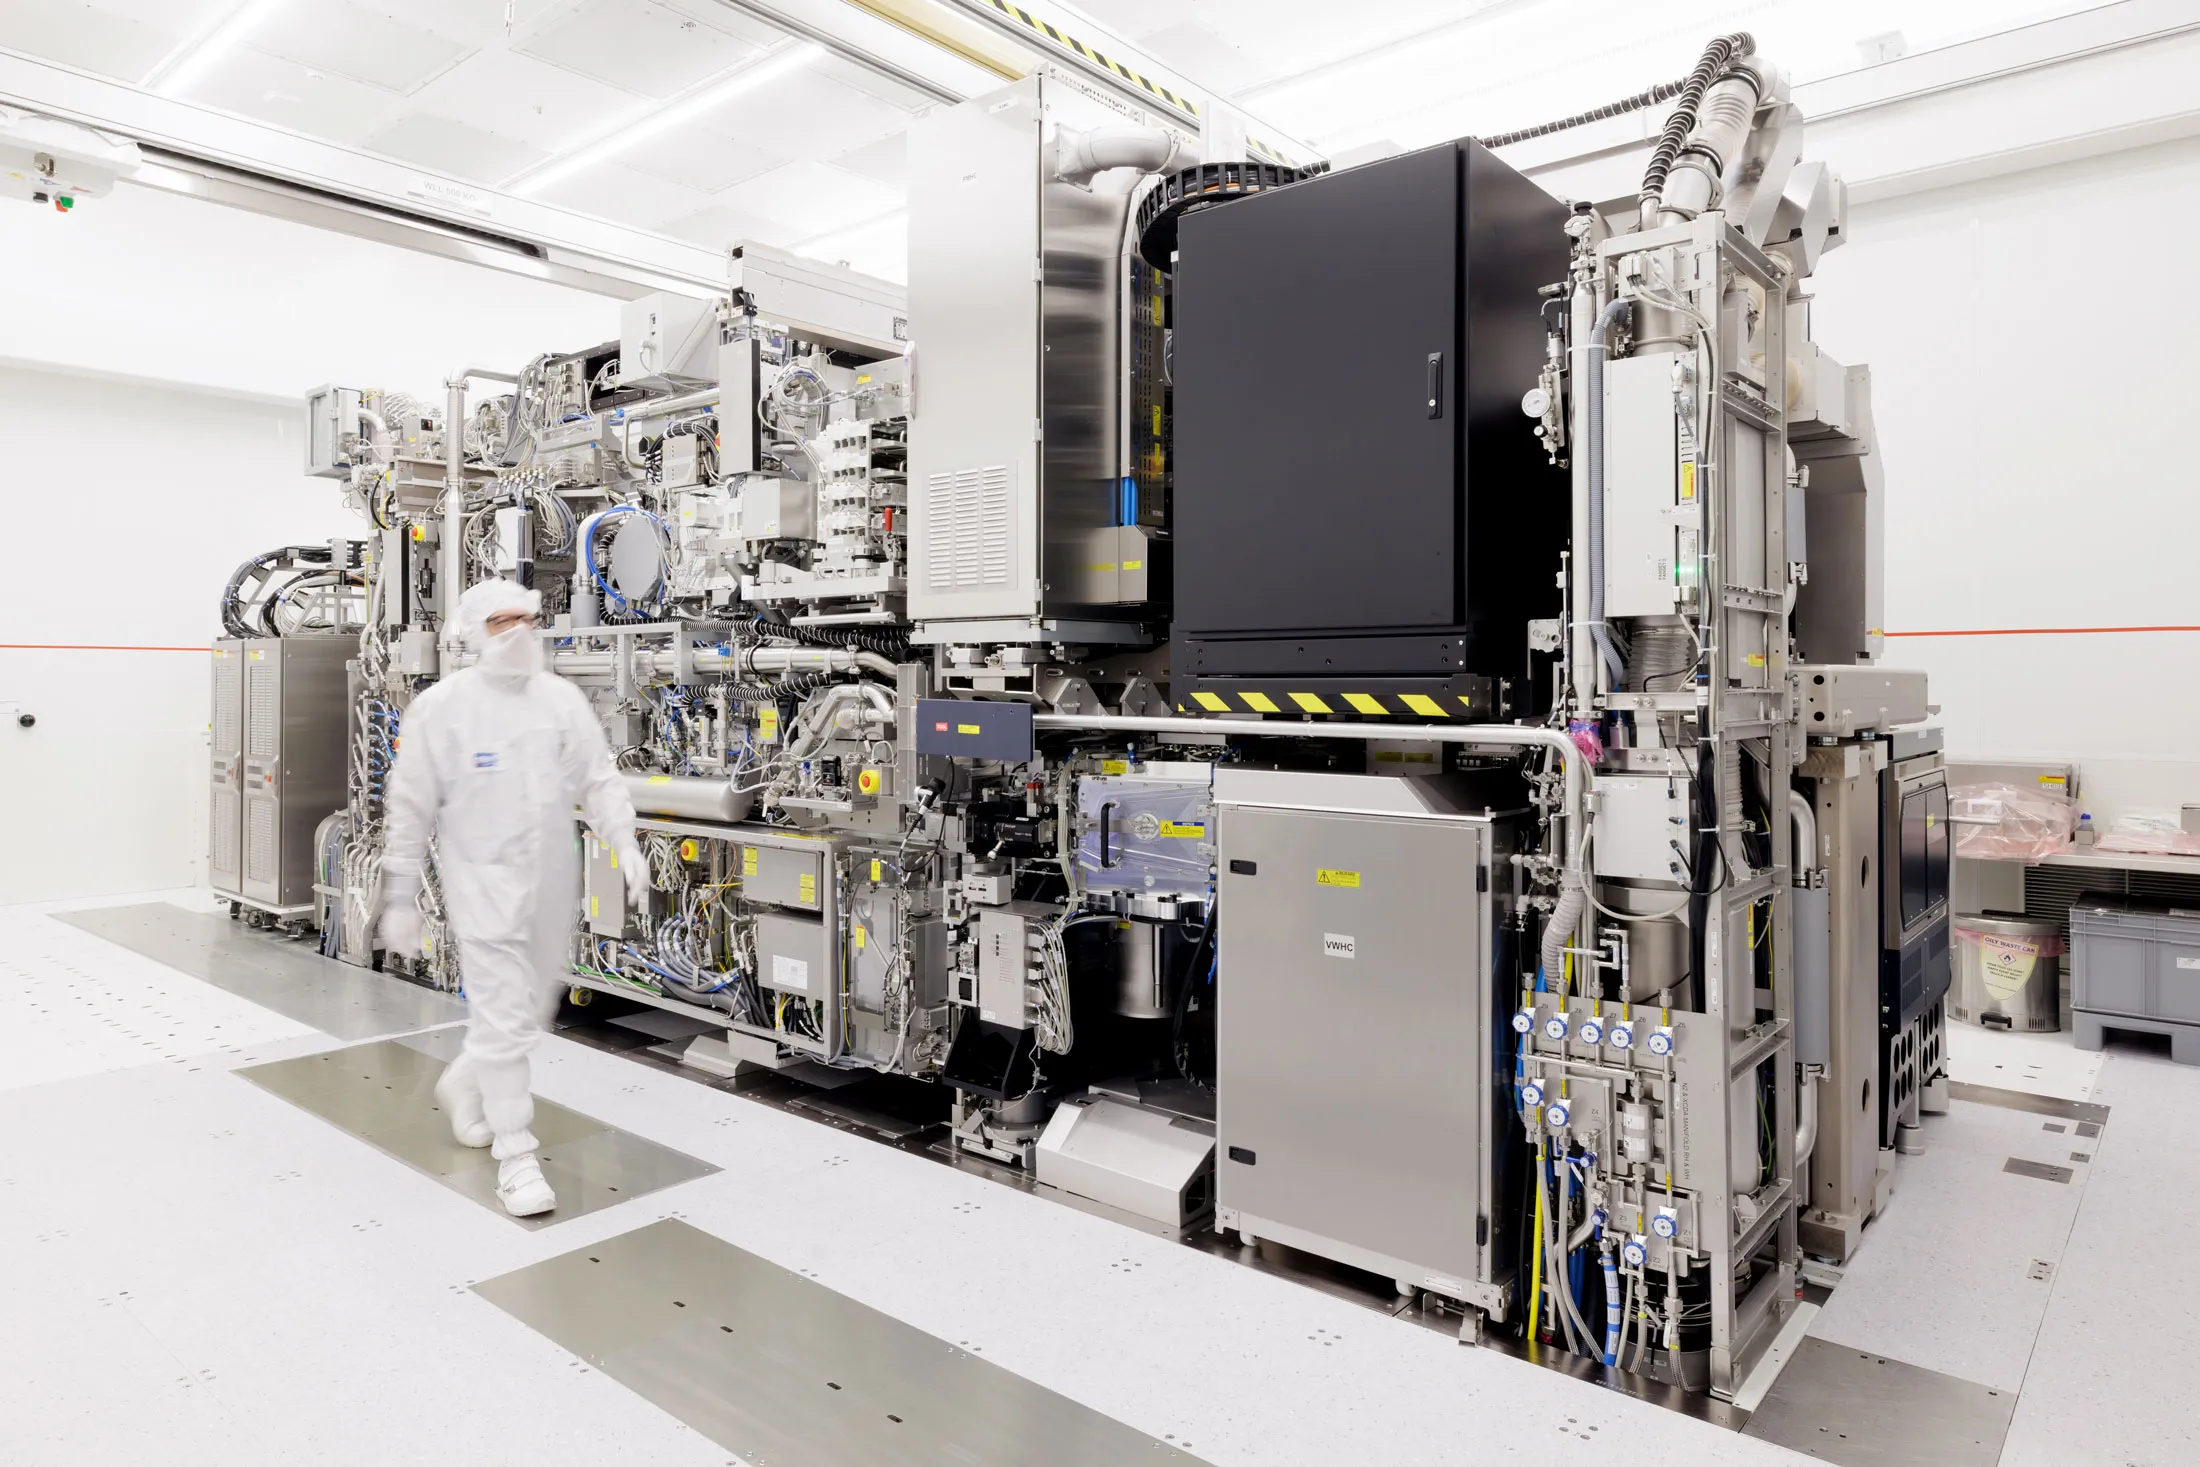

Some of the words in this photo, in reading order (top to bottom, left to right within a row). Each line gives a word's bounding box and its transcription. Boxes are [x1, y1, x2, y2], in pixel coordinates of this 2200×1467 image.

[1326, 940, 1353, 952] VWHC
[2000, 940, 2021, 950] WASTE
[1683, 1083, 1688, 1092] N2
